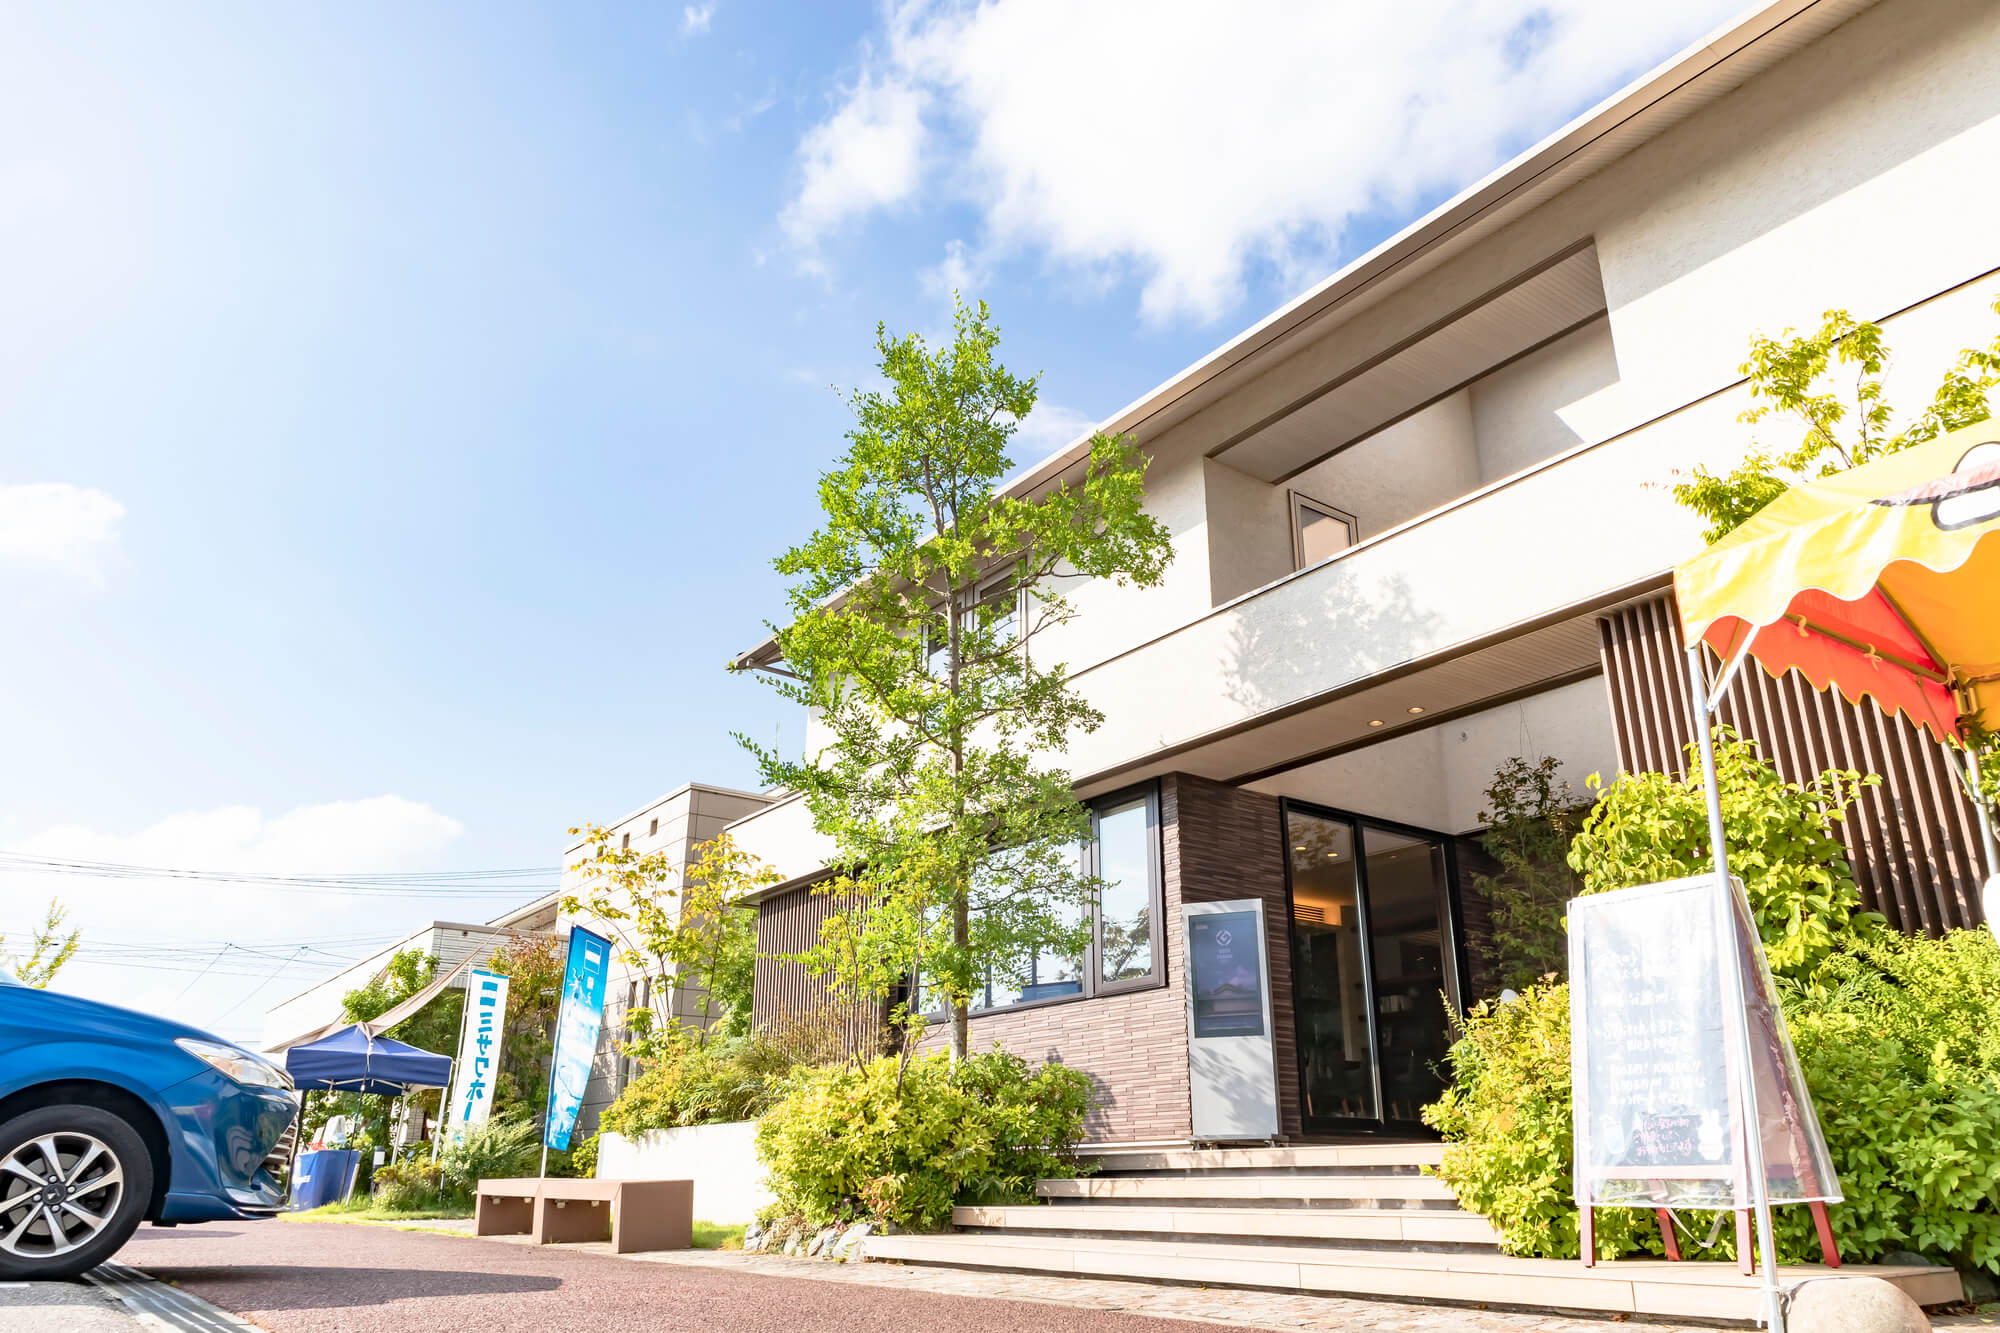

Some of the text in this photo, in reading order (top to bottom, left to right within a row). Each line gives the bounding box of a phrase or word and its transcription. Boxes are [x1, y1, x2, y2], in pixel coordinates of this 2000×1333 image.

[458, 1012, 492, 1139] ミサワホー
